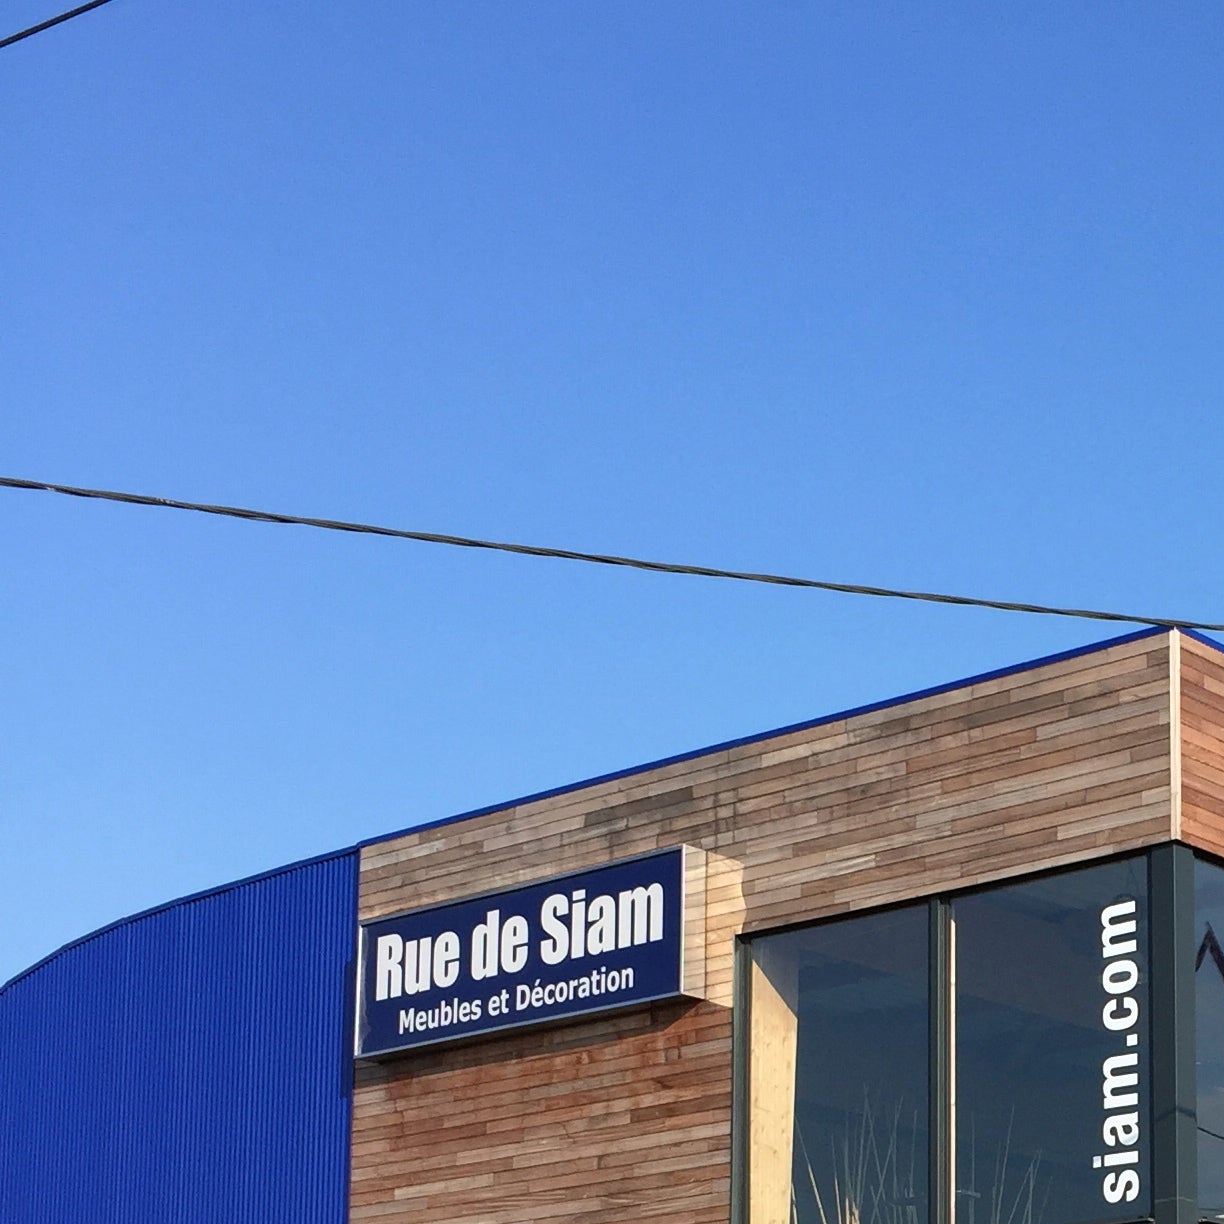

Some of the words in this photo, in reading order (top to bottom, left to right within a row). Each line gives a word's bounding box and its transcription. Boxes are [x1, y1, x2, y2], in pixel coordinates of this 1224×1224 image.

[375, 932, 460, 1001] Rue
[471, 909, 529, 980] de
[540, 882, 664, 965] Siam
[398, 1000, 482, 1035] Meubles
[488, 989, 510, 1017] et
[516, 966, 634, 1012] Décoration
[1092, 900, 1140, 1204] siam.com
